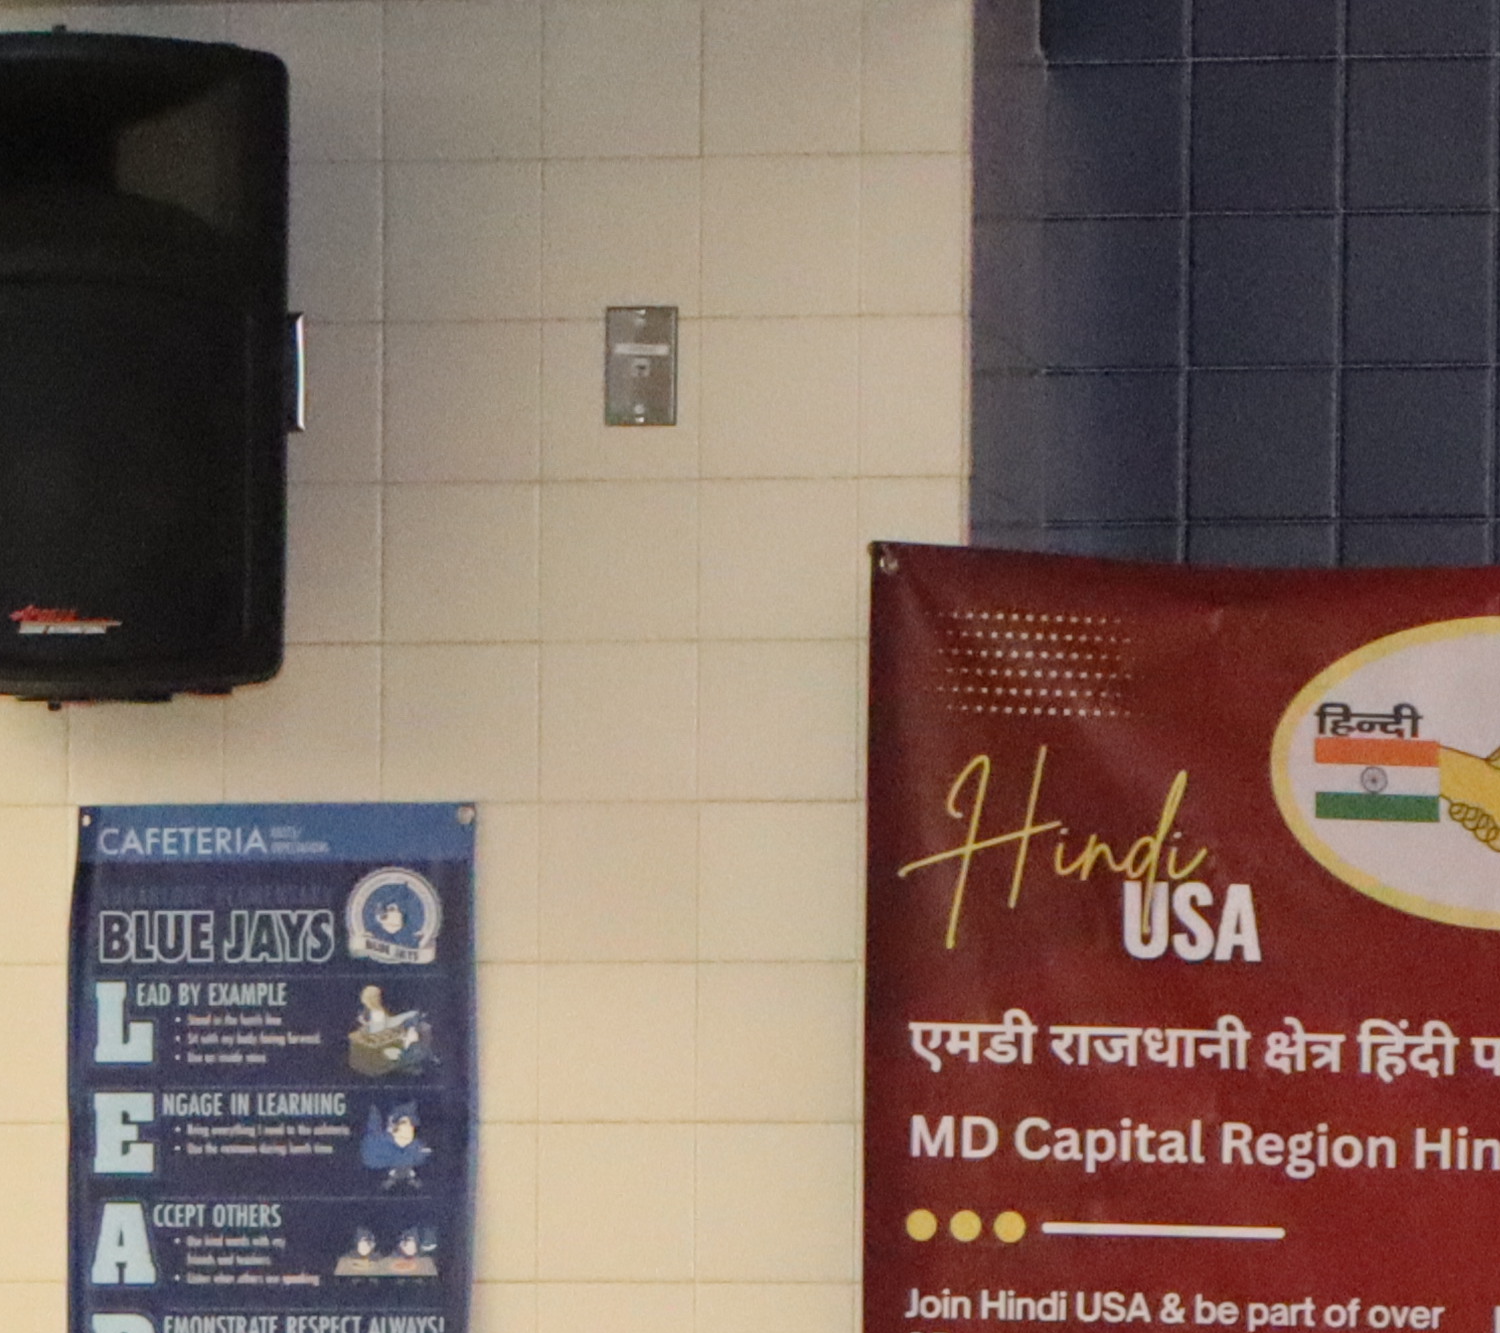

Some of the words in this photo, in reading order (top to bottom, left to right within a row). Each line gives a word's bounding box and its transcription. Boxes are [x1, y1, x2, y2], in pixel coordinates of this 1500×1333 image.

[1314, 701, 1422, 739] हिन्दी
[99, 826, 268, 856] CAFETERIA
[897, 745, 1207, 949] Hindi
[99, 909, 214, 963] BLUE
[223, 909, 335, 963] JAYS
[1122, 880, 1262, 962] USA
[94, 981, 154, 1063] L
[136, 982, 171, 1007] EAD
[178, 982, 201, 1007] BY
[208, 982, 288, 1007] EXAMPLE
[908, 1007, 1037, 1074] एमडी
[1049, 1014, 1252, 1071] राजधानी
[1264, 1016, 1347, 1075] क्षेत्र
[1357, 1018, 1460, 1084] हिंदी
[93, 1091, 154, 1174] E
[162, 1092, 223, 1117] NGAGE
[230, 1092, 250, 1117] IN
[257, 1092, 347, 1117] LEARNING
[910, 1114, 999, 1159] MD
[1014, 1116, 1206, 1174] Capital
[1221, 1121, 1397, 1180] Region
[91, 1201, 156, 1285] A
[153, 1204, 205, 1228] CCEPT
[212, 1204, 283, 1228] OTHERS
[904, 1287, 971, 1320] Join
[980, 1289, 1067, 1322] Hindi
[1075, 1290, 1151, 1323] USA
[1159, 1292, 1185, 1325] &
[1194, 1293, 1239, 1326] be
[1247, 1296, 1316, 1333] part
[1324, 1297, 1361, 1329] of
[1368, 1303, 1445, 1330] over
